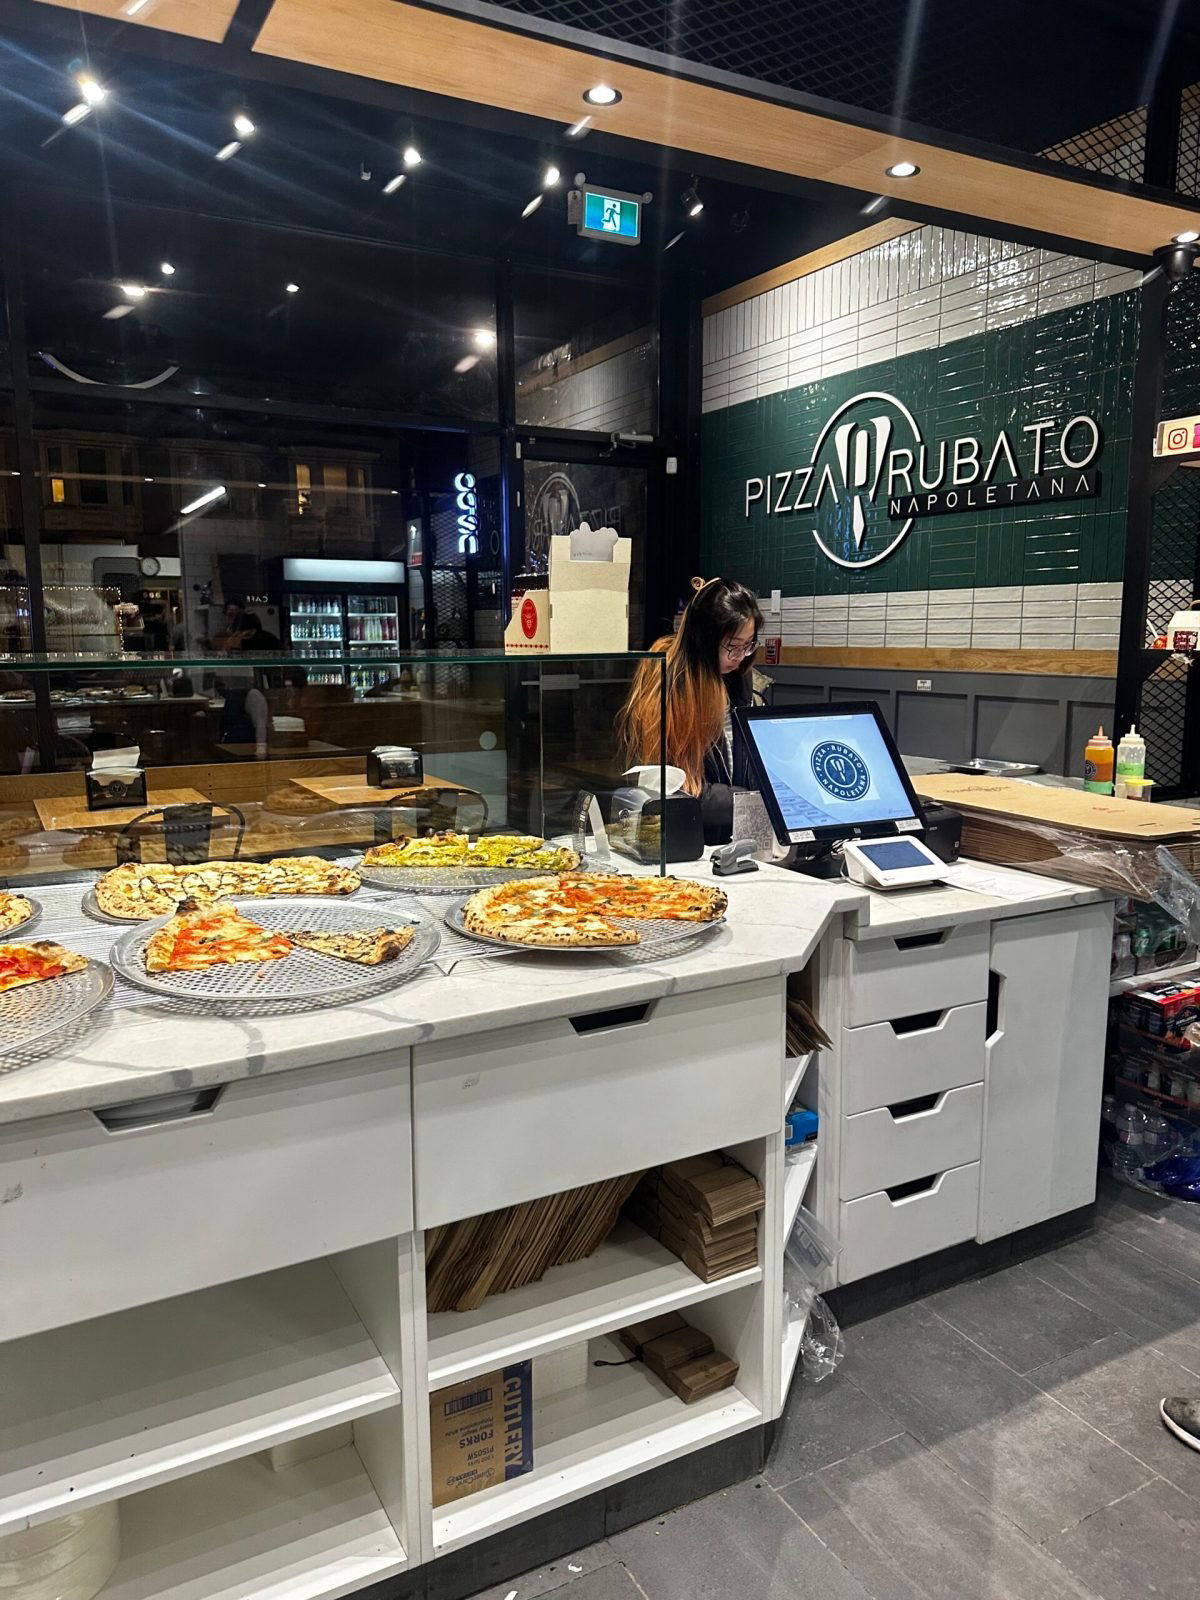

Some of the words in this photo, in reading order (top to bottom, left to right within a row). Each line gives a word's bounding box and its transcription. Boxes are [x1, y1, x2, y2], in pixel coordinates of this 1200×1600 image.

[745, 463, 841, 518] PIZZA
[888, 414, 1100, 496] RUBATO
[889, 472, 1091, 516] NAPOLETANA
[815, 749, 827, 771] PIZZA
[831, 745, 863, 768] RUBATO
[822, 775, 866, 797] NAPOLETANA
[504, 1376, 523, 1467] CUTLERY
[458, 1429, 494, 1449] FORKS
